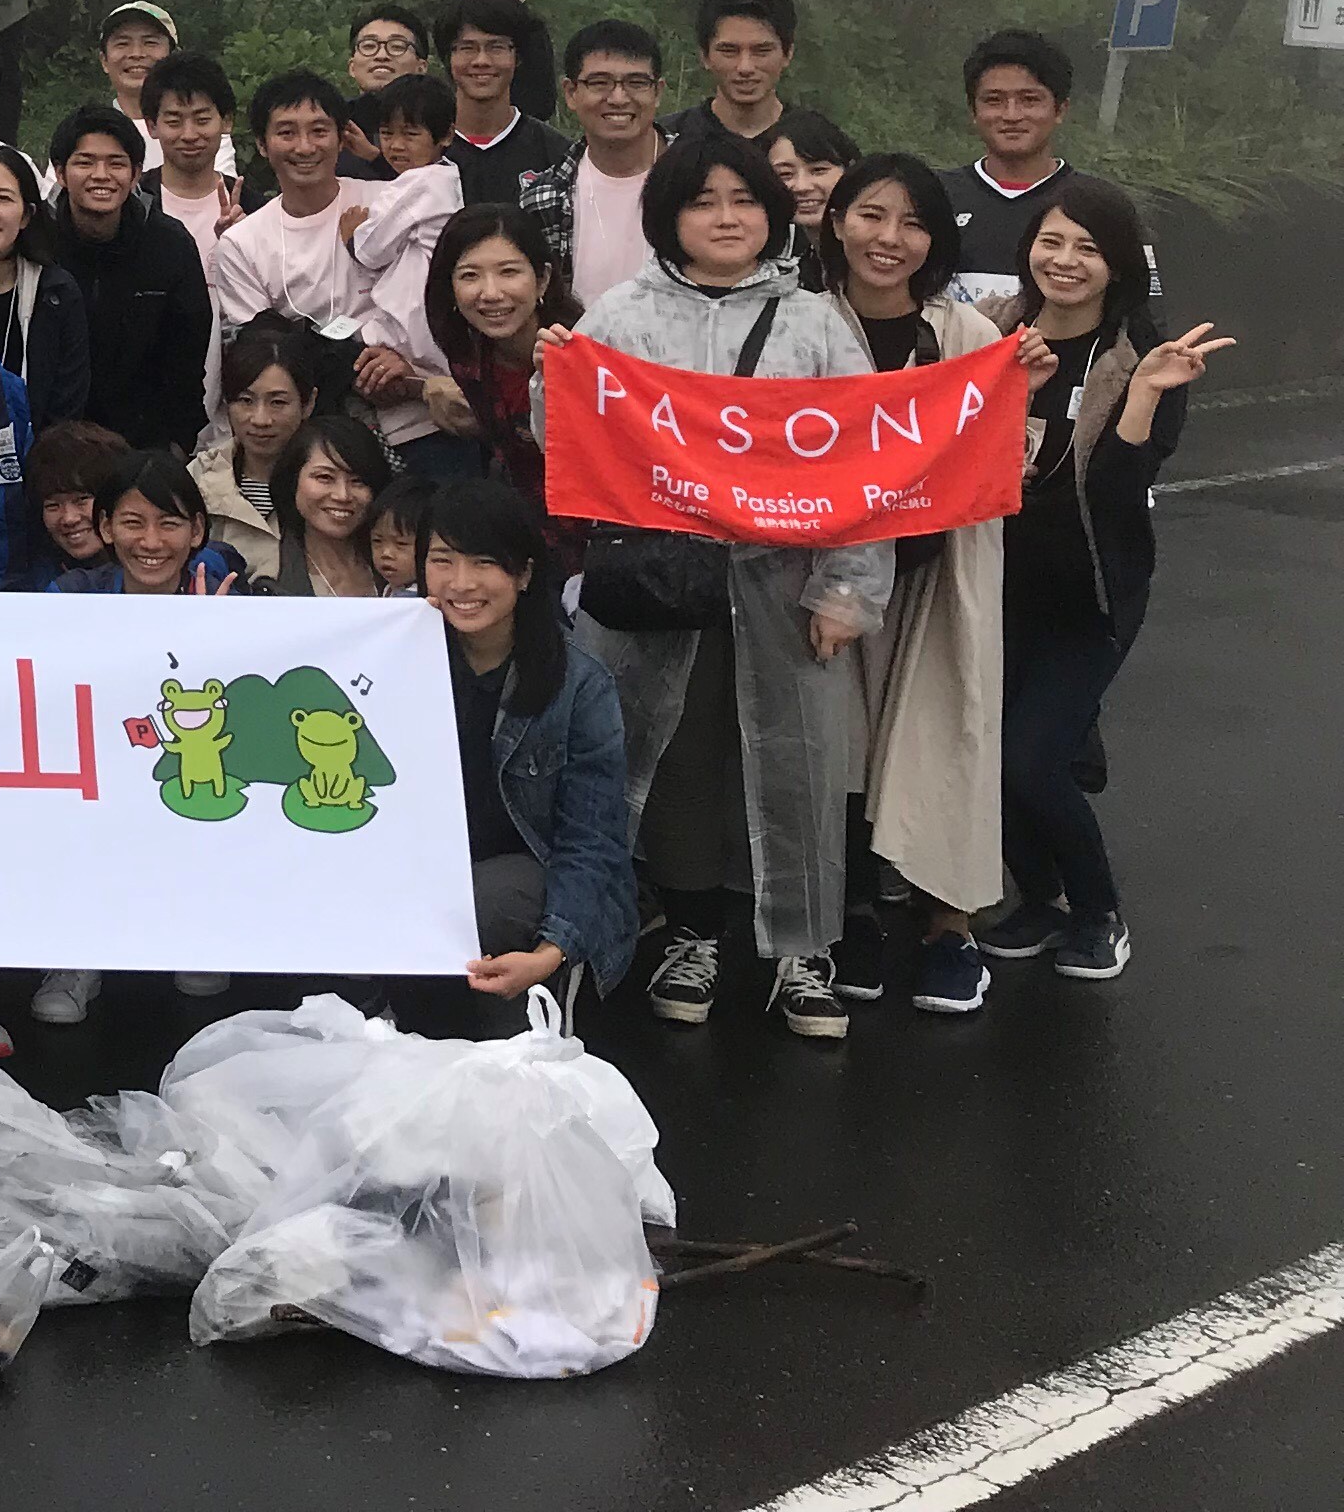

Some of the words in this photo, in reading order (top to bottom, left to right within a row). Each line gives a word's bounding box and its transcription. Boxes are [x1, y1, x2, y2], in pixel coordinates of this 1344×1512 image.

[597, 365, 987, 459] PASONA
[652, 464, 710, 502] Pure
[732, 486, 833, 514] Passion
[136, 725, 149, 739] P
